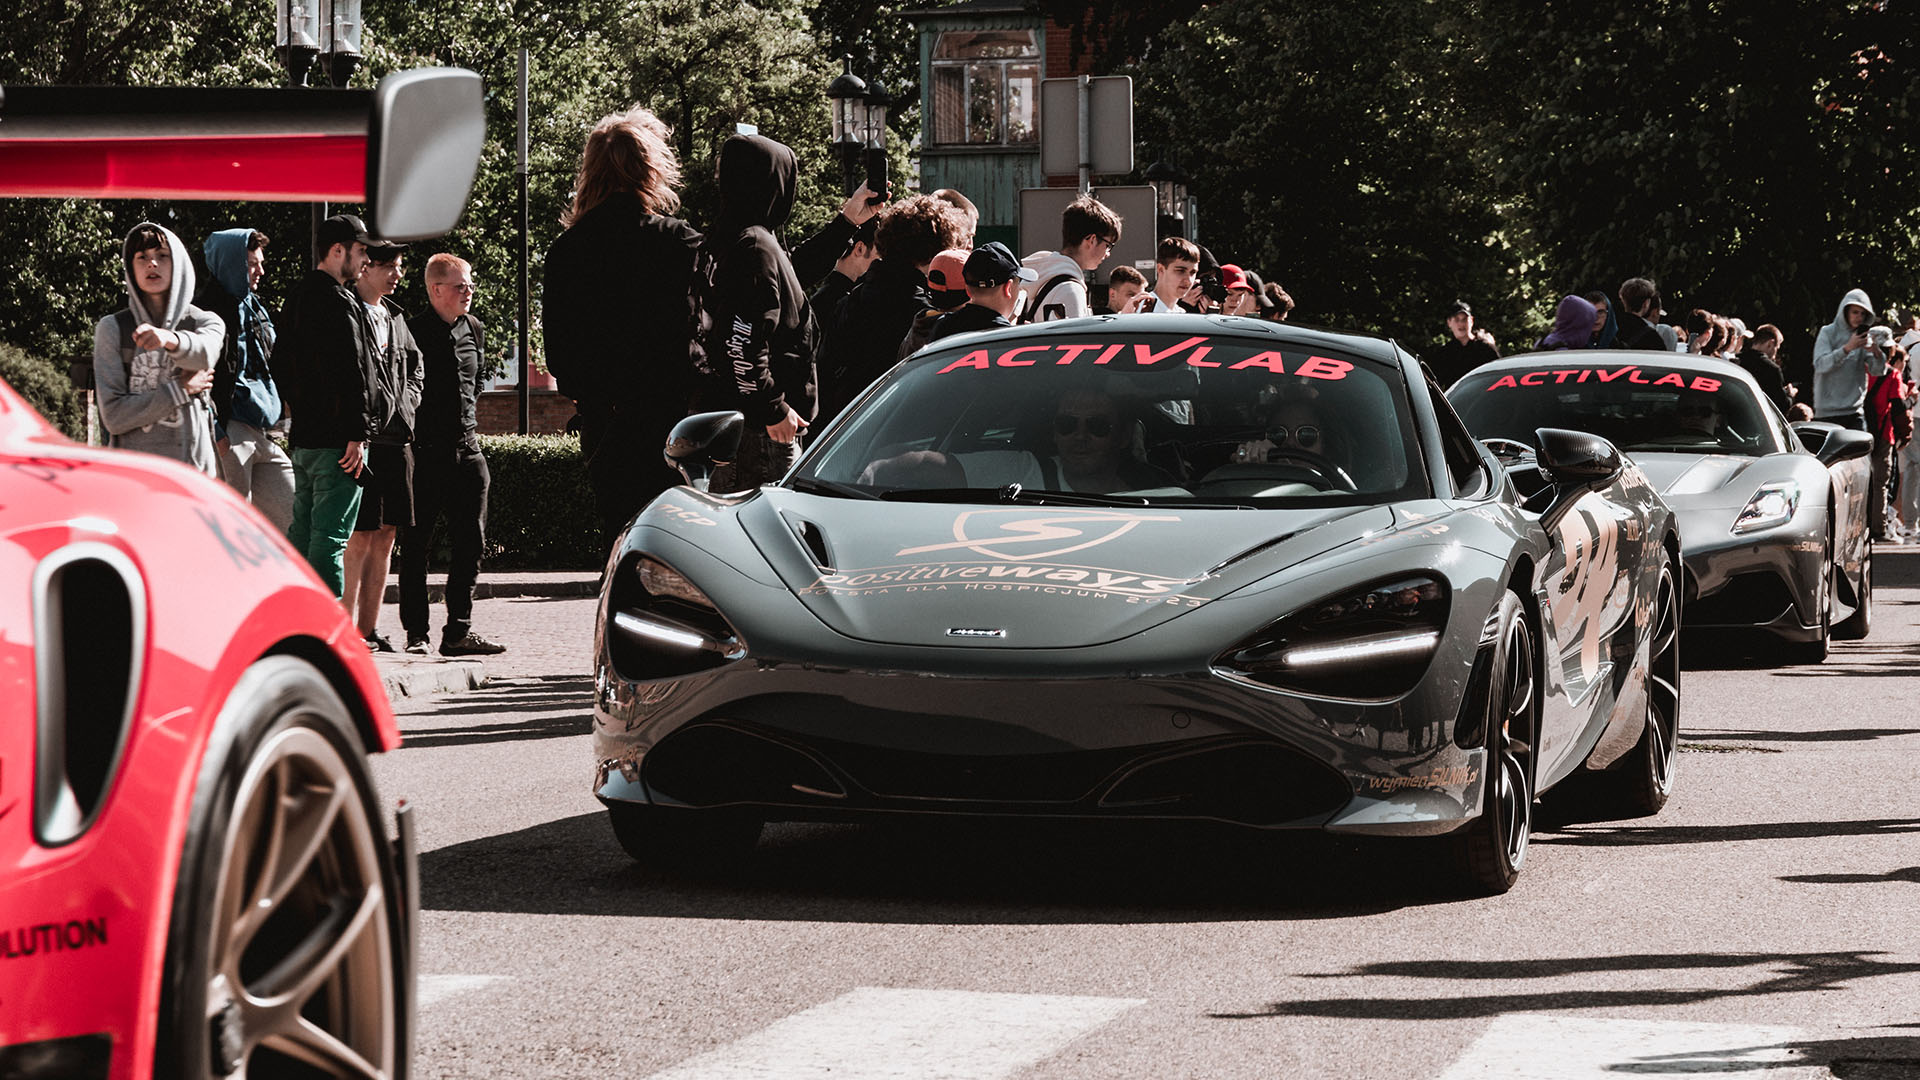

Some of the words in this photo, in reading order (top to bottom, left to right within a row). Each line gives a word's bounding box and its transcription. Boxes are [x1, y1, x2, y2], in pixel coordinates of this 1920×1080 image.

[936, 336, 1355, 381] ACTIVLAB
[1487, 365, 1723, 392] ACTIVLAB
[798, 587, 889, 598] POLSKA
[906, 583, 948, 593] DLA
[964, 582, 1109, 600] HOSPICJUM
[0, 917, 107, 957] LUTION
